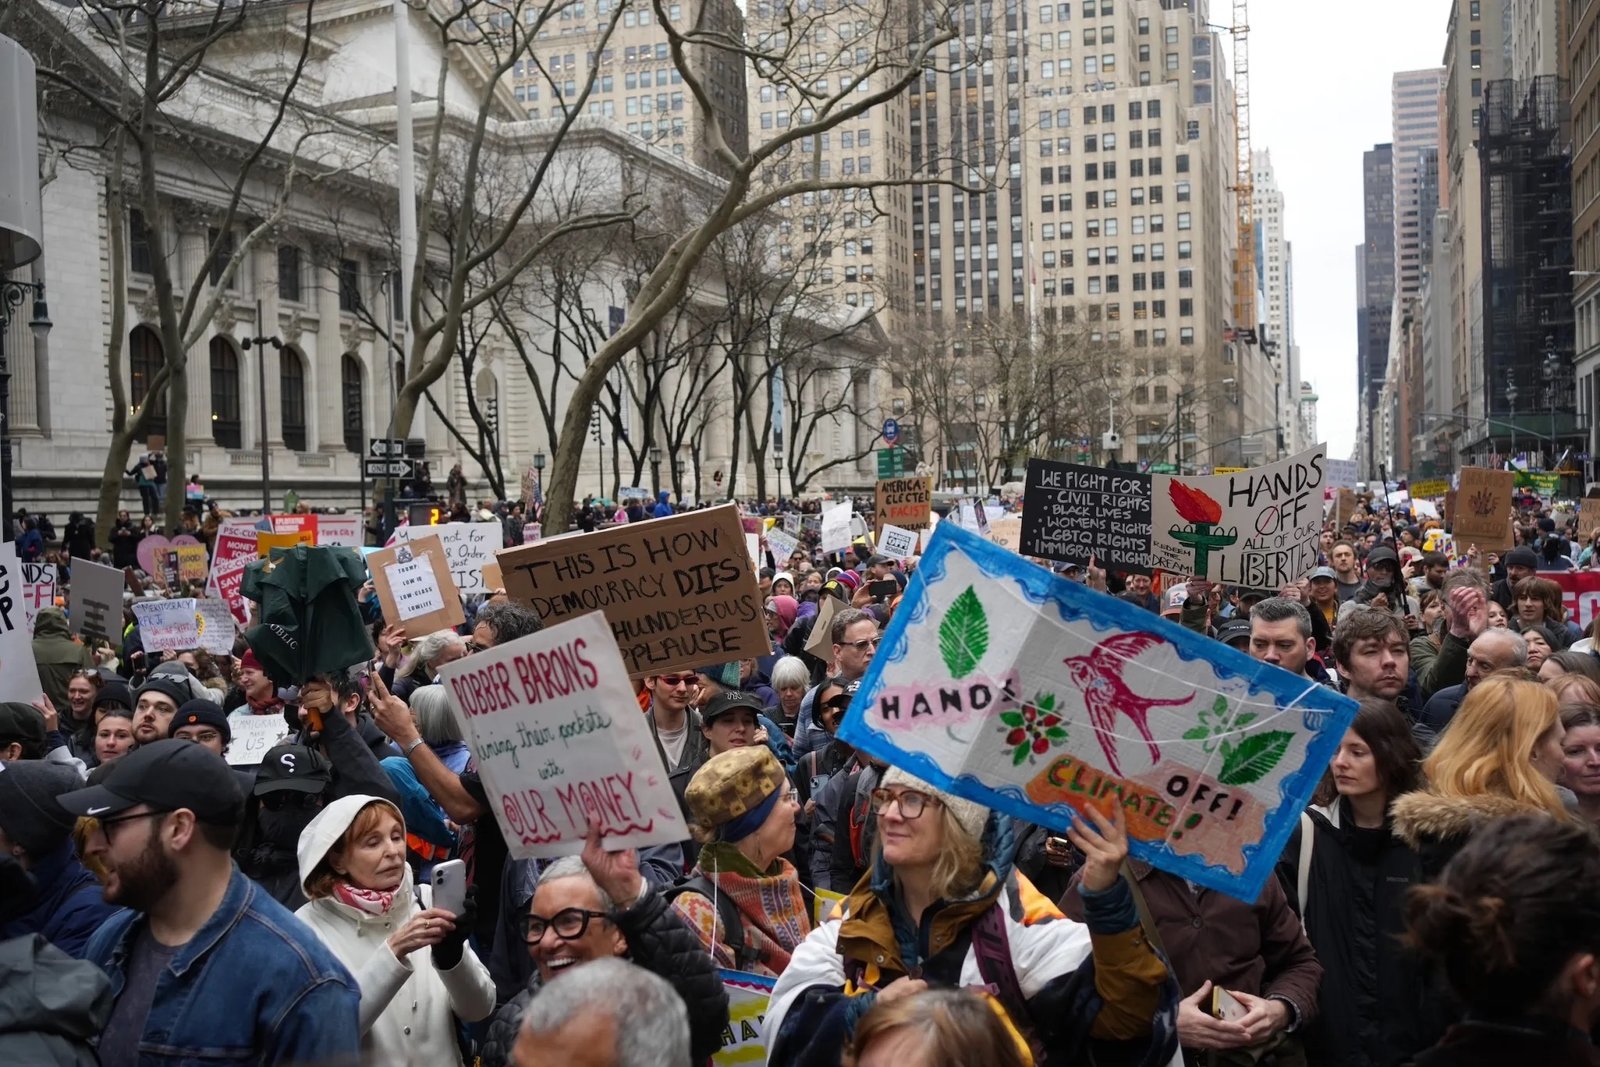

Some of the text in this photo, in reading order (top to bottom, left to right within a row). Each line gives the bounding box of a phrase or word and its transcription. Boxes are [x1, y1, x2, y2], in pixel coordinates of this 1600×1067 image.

[371, 464, 407, 473] ONE WAY
[1041, 469, 1061, 487] WE
[1066, 472, 1108, 491] FIGHT
[1229, 453, 1323, 508] HANDS
[886, 490, 930, 505] ELECTED
[1057, 490, 1151, 512] CIVIL RIGHTS
[879, 504, 928, 518] A FACIST
[1052, 504, 1132, 520] BLACK LIVES
[1255, 491, 1310, 537] OFF
[443, 529, 485, 542] not for
[1047, 516, 1153, 536] WOMENS RIGHTS
[1243, 520, 1317, 550] ALL OF OUR
[227, 540, 255, 552] MONEY
[1041, 527, 1146, 551] LGBTQ RIGHTS
[1153, 540, 1191, 557] REDEEM
[450, 558, 468, 569] just
[514, 528, 718, 588] THIS IS HOW
[1035, 539, 1152, 568] IMMIGRANT RIGHTS
[1152, 553, 1193, 575] DREAM!
[22, 564, 54, 585] NDS
[402, 578, 415, 586] LOW
[531, 558, 741, 619] DEMOCRACY DIES
[611, 595, 757, 642] HUNDEROUS
[270, 623, 298, 650] UBLIC
[451, 638, 599, 720] ROBBER BARONS
[246, 737, 265, 751] US
[476, 705, 612, 768] lining their pockets
[538, 759, 565, 781] with
[502, 771, 641, 837] OUR MONEY
[1166, 775, 1243, 821] OFF!
